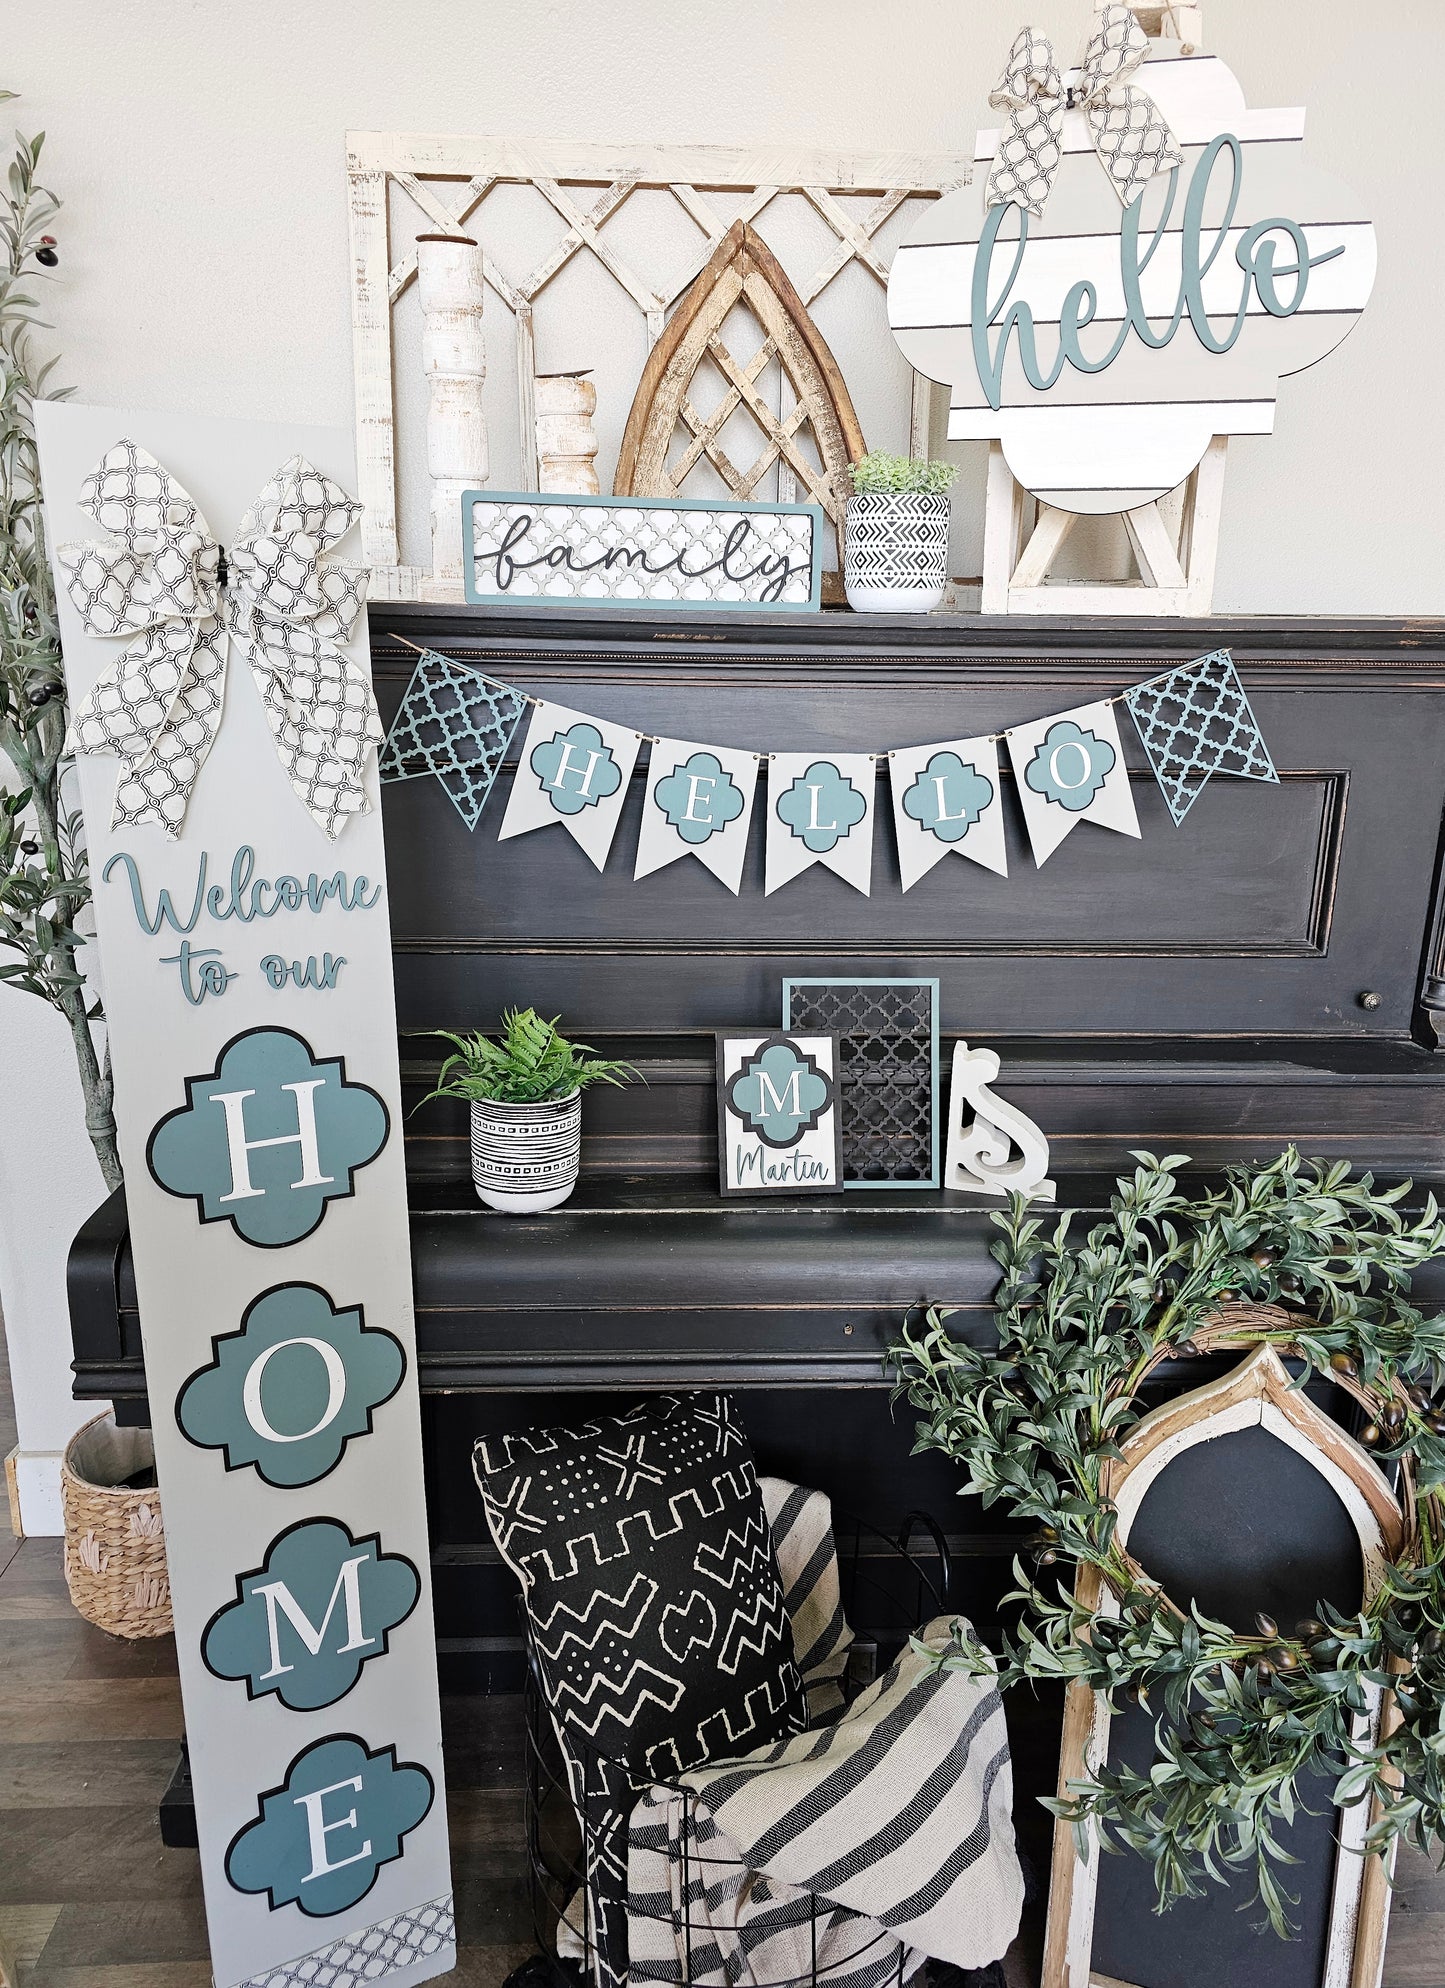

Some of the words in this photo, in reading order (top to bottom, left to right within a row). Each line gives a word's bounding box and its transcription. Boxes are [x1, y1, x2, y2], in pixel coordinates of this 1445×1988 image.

[971, 133, 1346, 412] hello
[474, 514, 811, 602] family
[548, 740, 1094, 830] HELLO
[102, 844, 382, 936] Welcome
[159, 940, 239, 1006] to
[260, 952, 347, 991] our
[755, 1070, 806, 1118] M
[736, 1144, 830, 1186] Martin
[208, 1078, 377, 1884] HOME
